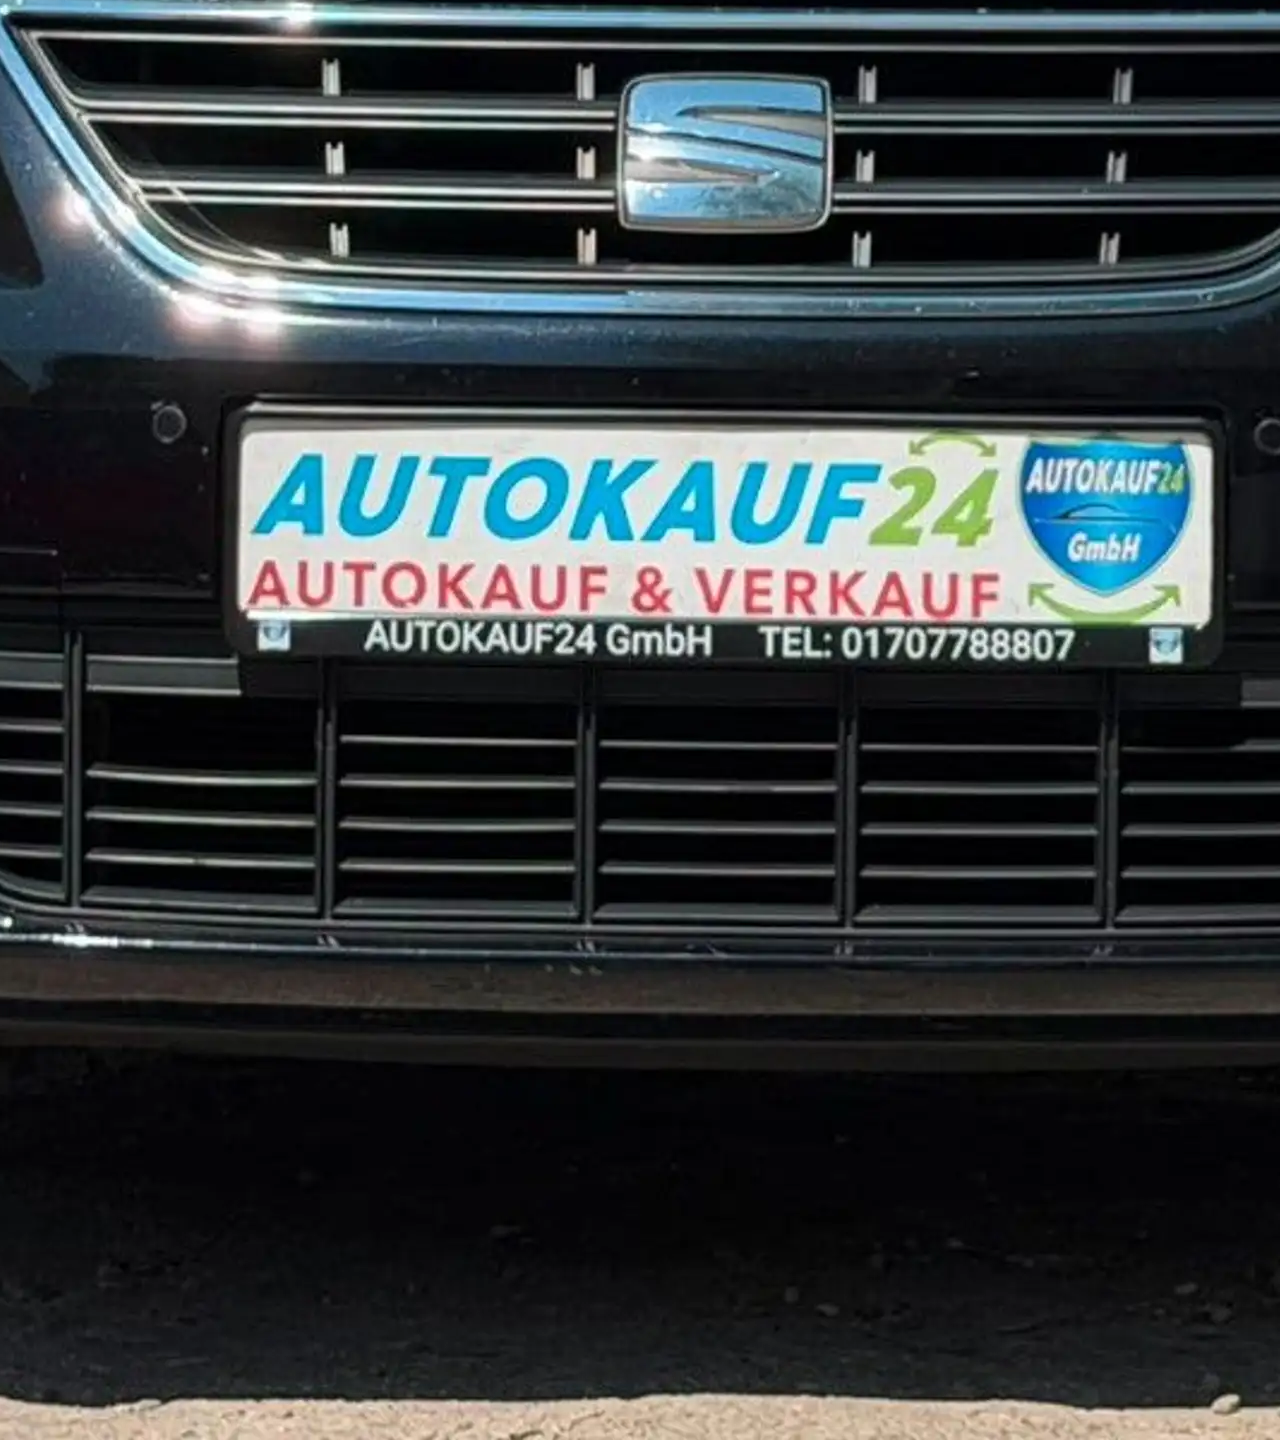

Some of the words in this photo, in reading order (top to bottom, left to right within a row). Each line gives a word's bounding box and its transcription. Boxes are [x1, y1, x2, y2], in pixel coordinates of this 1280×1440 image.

[1026, 458, 1186, 494] AUTOKAUF24
[251, 452, 1000, 548] AUTOKAUF24
[1067, 531, 1142, 563] GmbH
[247, 559, 609, 612] AUTOKAUF
[631, 565, 673, 614] &
[694, 567, 1001, 618] VERKAUF
[364, 620, 596, 655] AUTOKAUF24
[606, 624, 712, 657] GmbH
